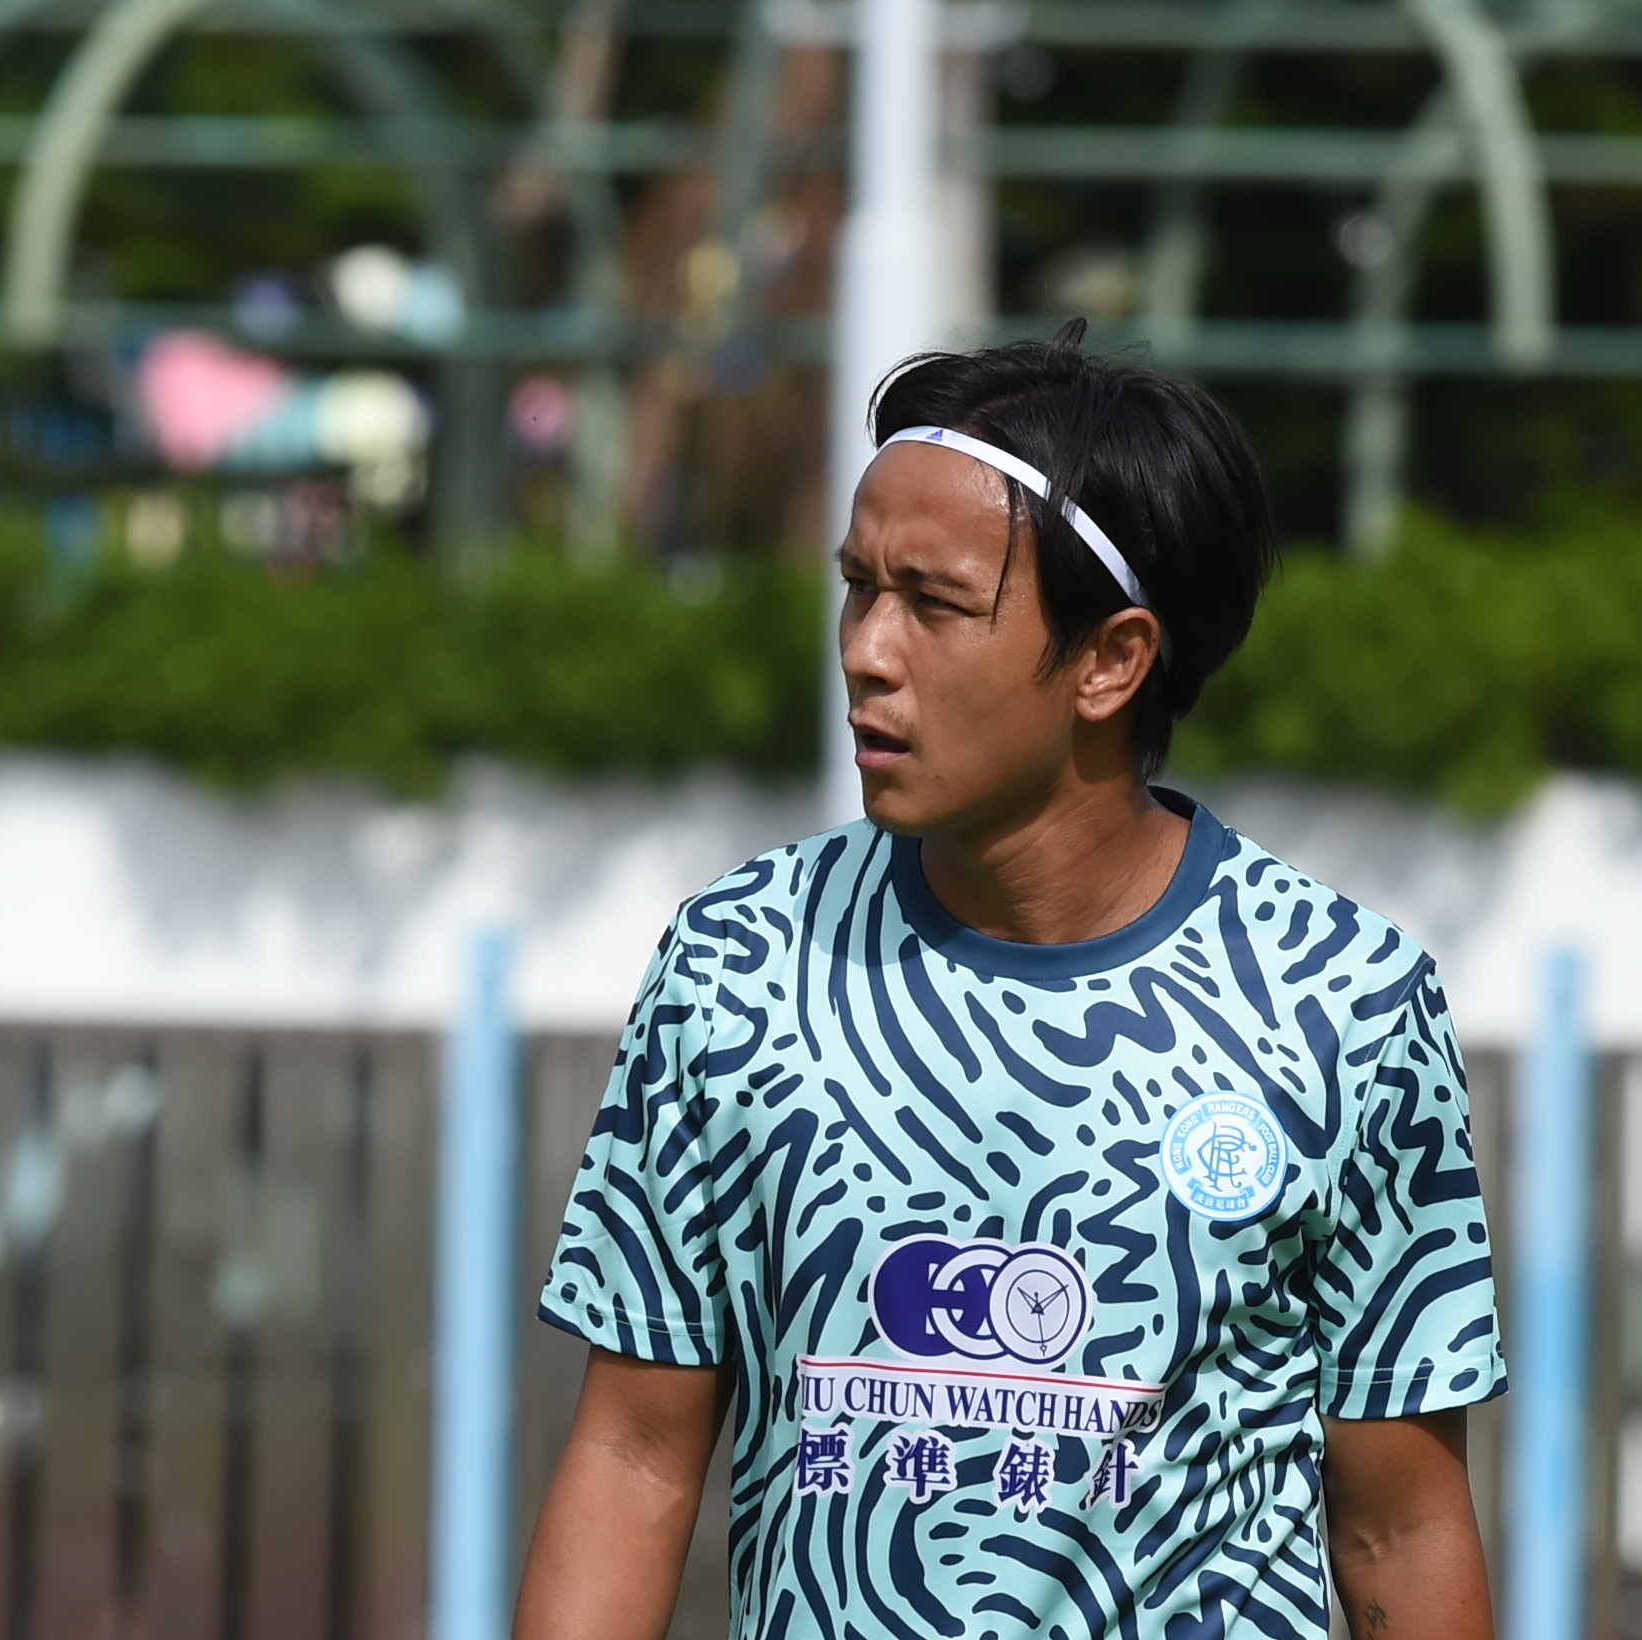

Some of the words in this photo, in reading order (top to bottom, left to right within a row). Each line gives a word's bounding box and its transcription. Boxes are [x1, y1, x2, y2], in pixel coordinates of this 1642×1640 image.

[1207, 1102, 1256, 1120] RANGERS
[1177, 1115, 1199, 1138] KONG
[1172, 1142, 1185, 1170] HONG
[801, 1374, 835, 1412] IU
[844, 1376, 936, 1419] CHUN
[945, 1384, 1058, 1429] WATCH
[1062, 1394, 1162, 1434] HANDS
